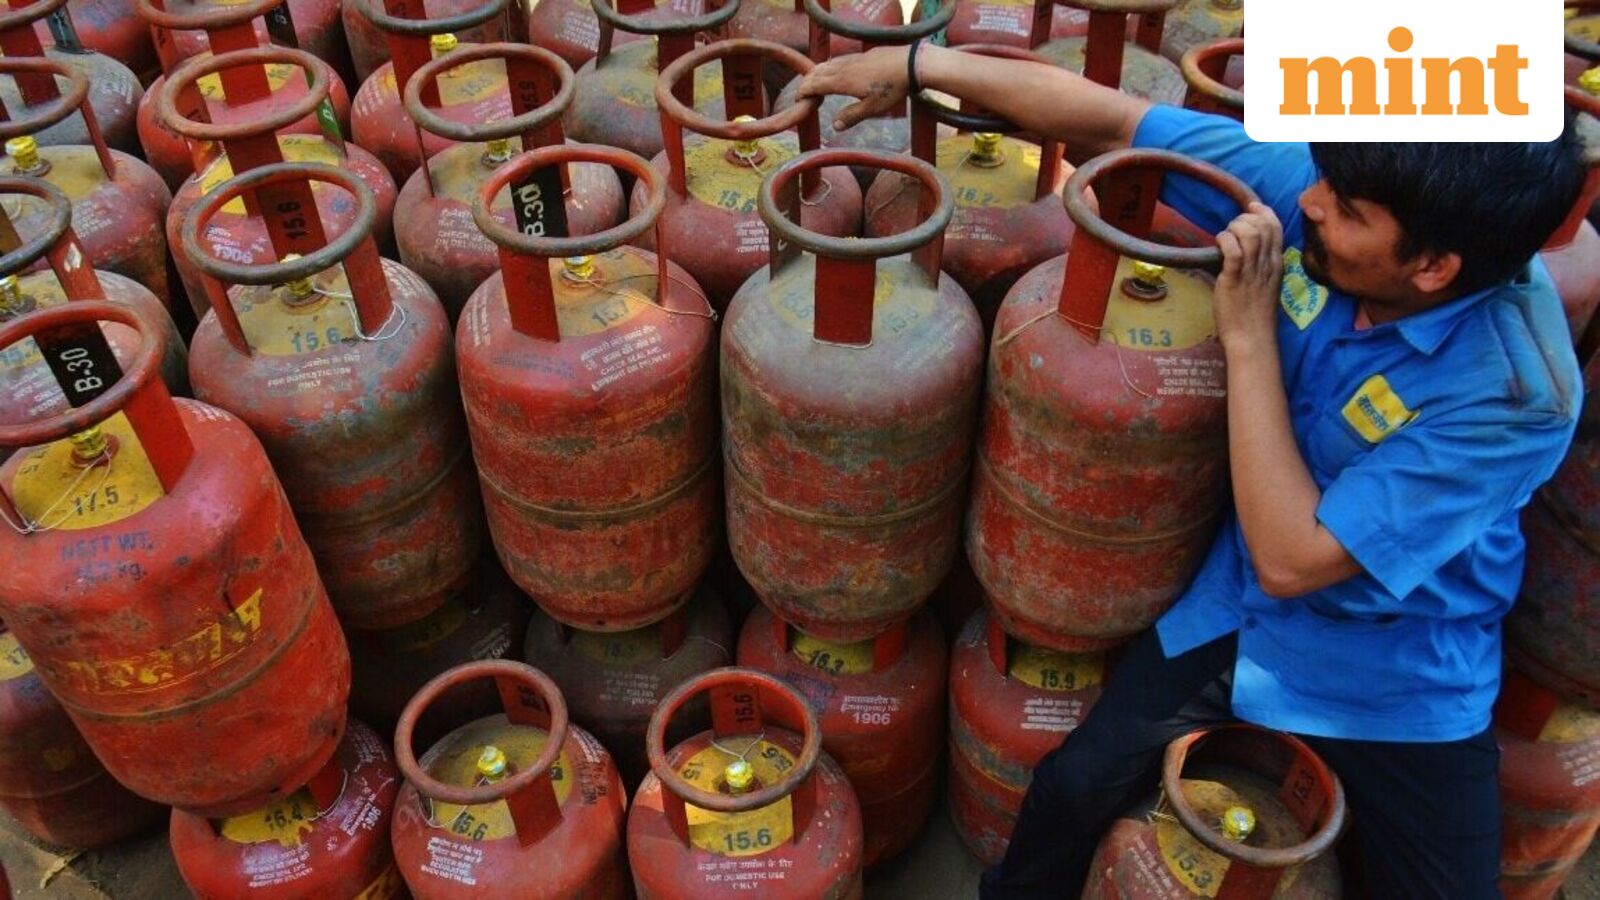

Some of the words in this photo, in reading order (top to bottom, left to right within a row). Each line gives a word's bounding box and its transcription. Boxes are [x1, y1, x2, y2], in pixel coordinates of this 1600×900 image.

[291, 326, 341, 353] 15.6
[1126, 327, 1173, 348] 16.3
[1041, 669, 1076, 690] 15.9
[852, 712, 891, 726] 1906
[452, 811, 488, 841] 15.6
[723, 827, 773, 852] 15.6
